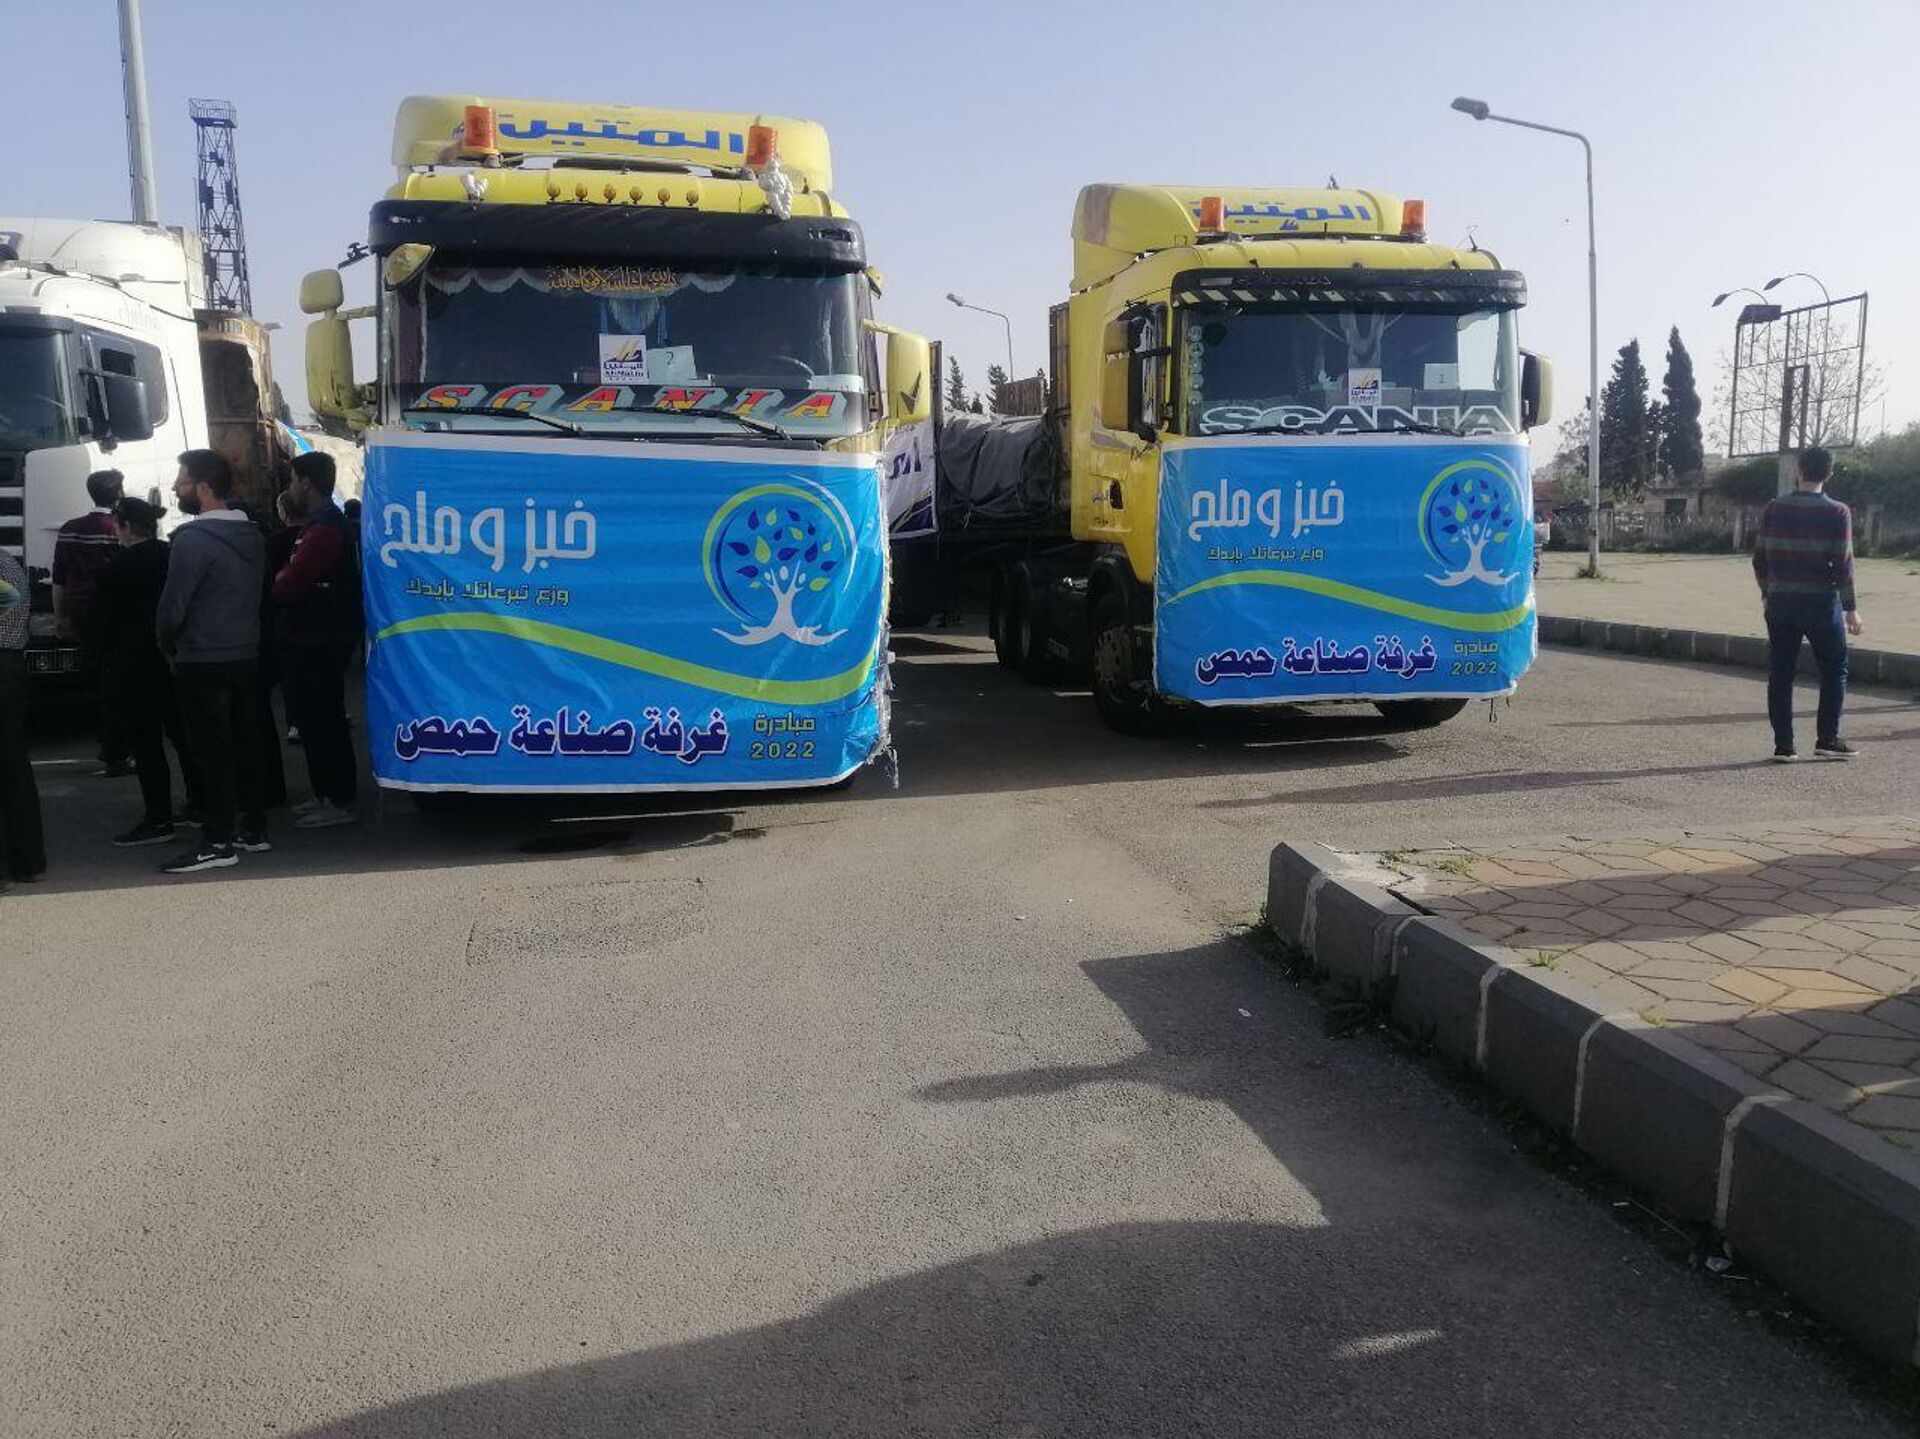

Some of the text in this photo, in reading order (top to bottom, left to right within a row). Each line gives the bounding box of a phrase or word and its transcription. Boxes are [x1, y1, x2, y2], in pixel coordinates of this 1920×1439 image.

[498, 113, 744, 154] المتين
[418, 384, 847, 419] SCANIA
[1200, 405, 1516, 435] SCANIA
[1188, 478, 1345, 541] خبز و ملح
[380, 490, 596, 573] خبز و ملح
[1195, 634, 1437, 684] غرفة صناعة حمص
[1453, 639, 1498, 656] مبادرة
[1450, 661, 1498, 676] 2022
[394, 704, 730, 764] غرفة صناعة حمص
[753, 713, 816, 737] مبادرة
[750, 741, 816, 759] 2022
